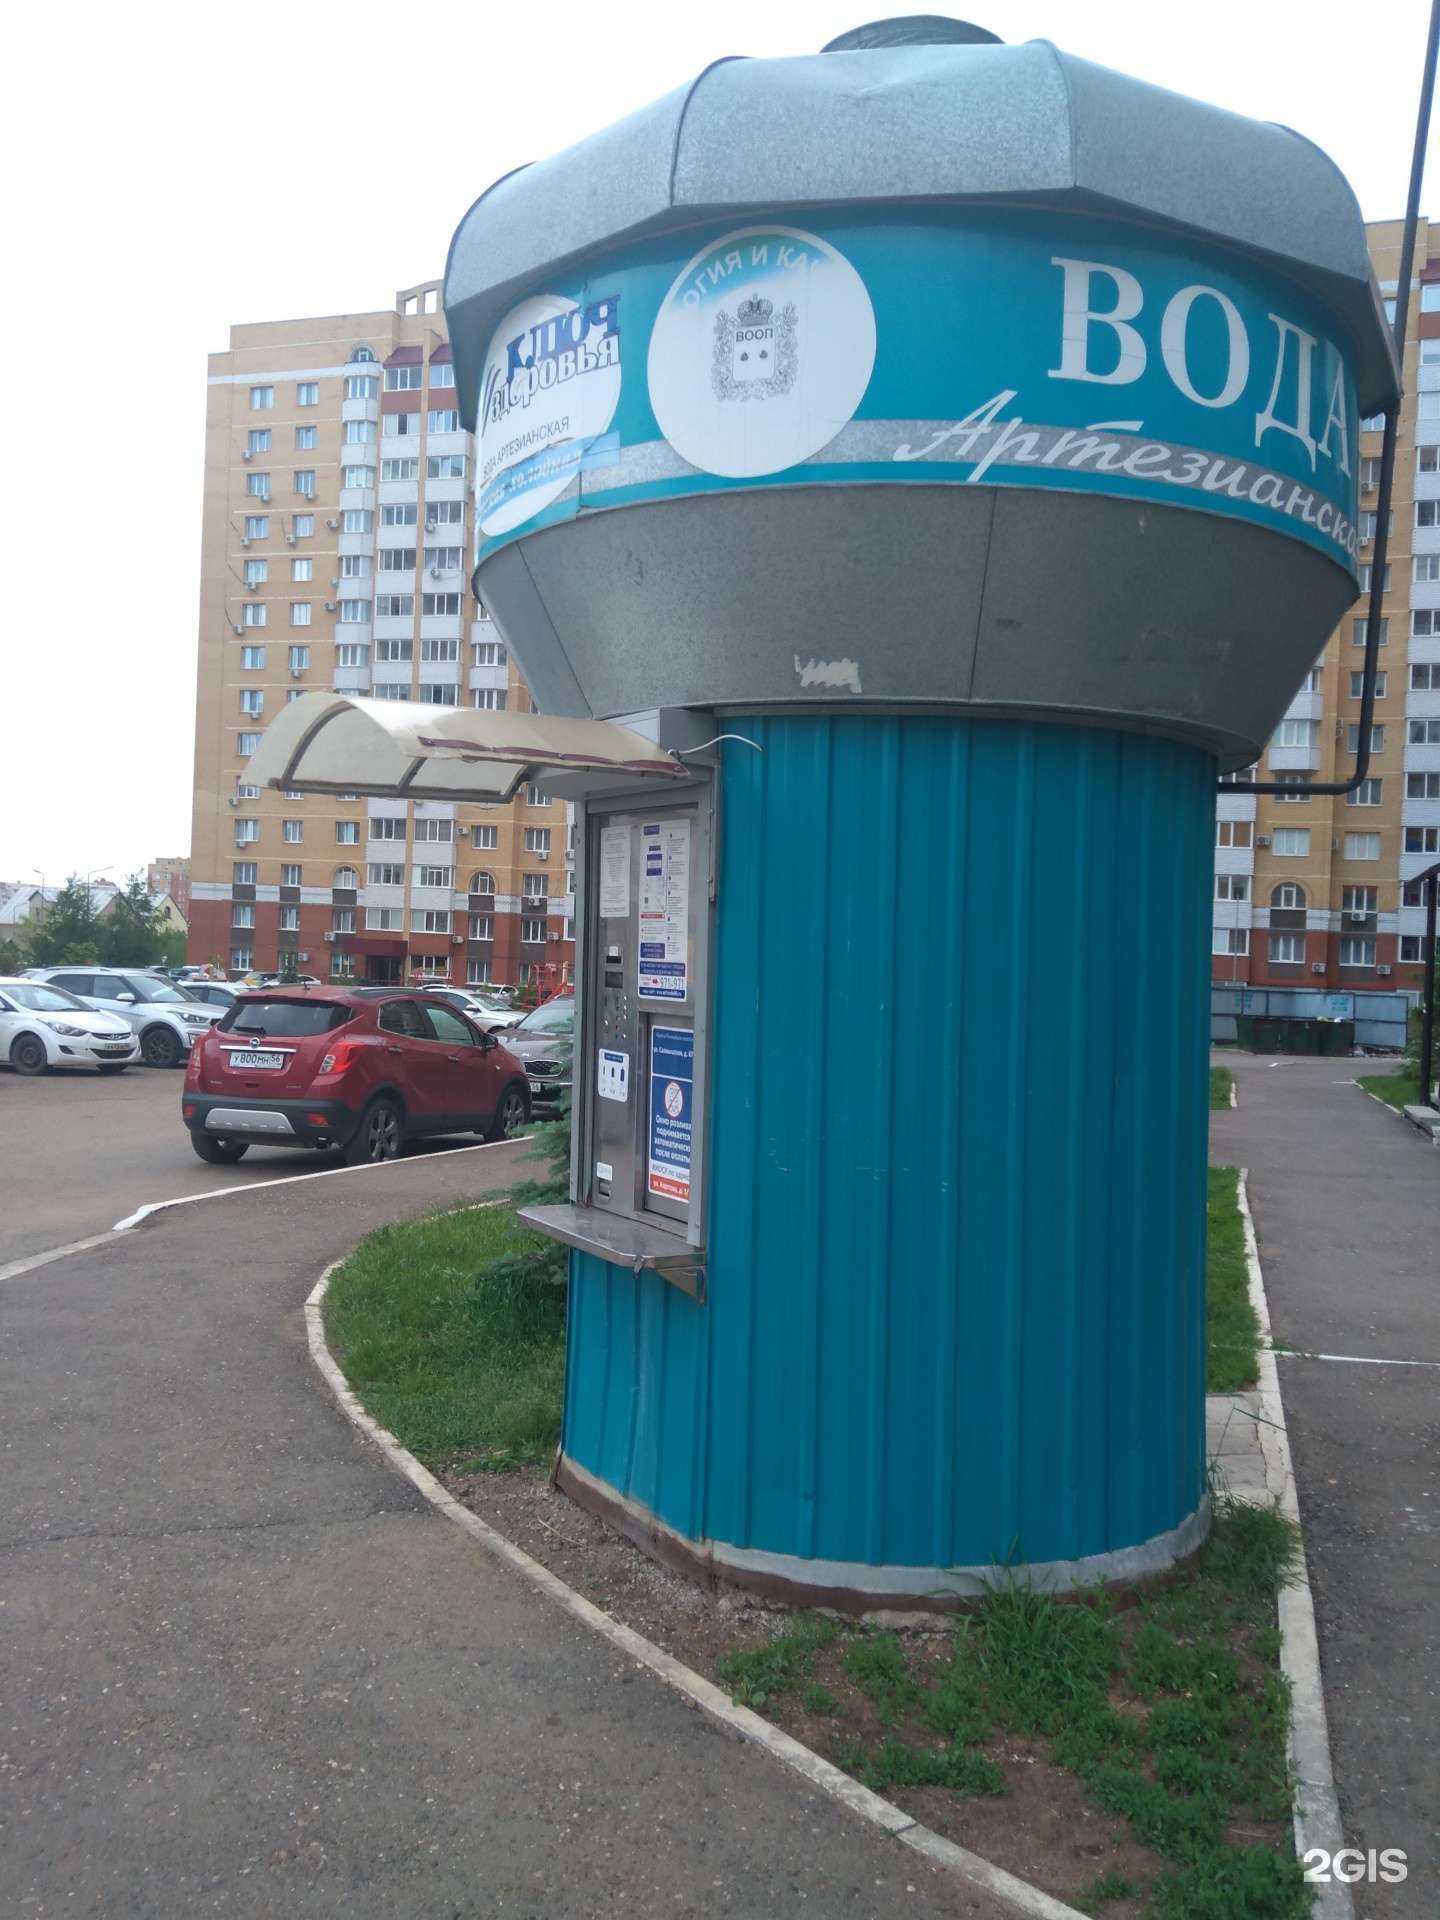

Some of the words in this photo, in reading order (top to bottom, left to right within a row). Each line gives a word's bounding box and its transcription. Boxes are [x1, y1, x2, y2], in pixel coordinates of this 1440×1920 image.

[751, 244, 768, 266] И
[735, 327, 774, 342] ВООП
[1047, 256, 1351, 479] ВОДА
[497, 416, 570, 464] АРТЕЗИАНСКАЯ
[270, 1054, 281, 1063] 56
